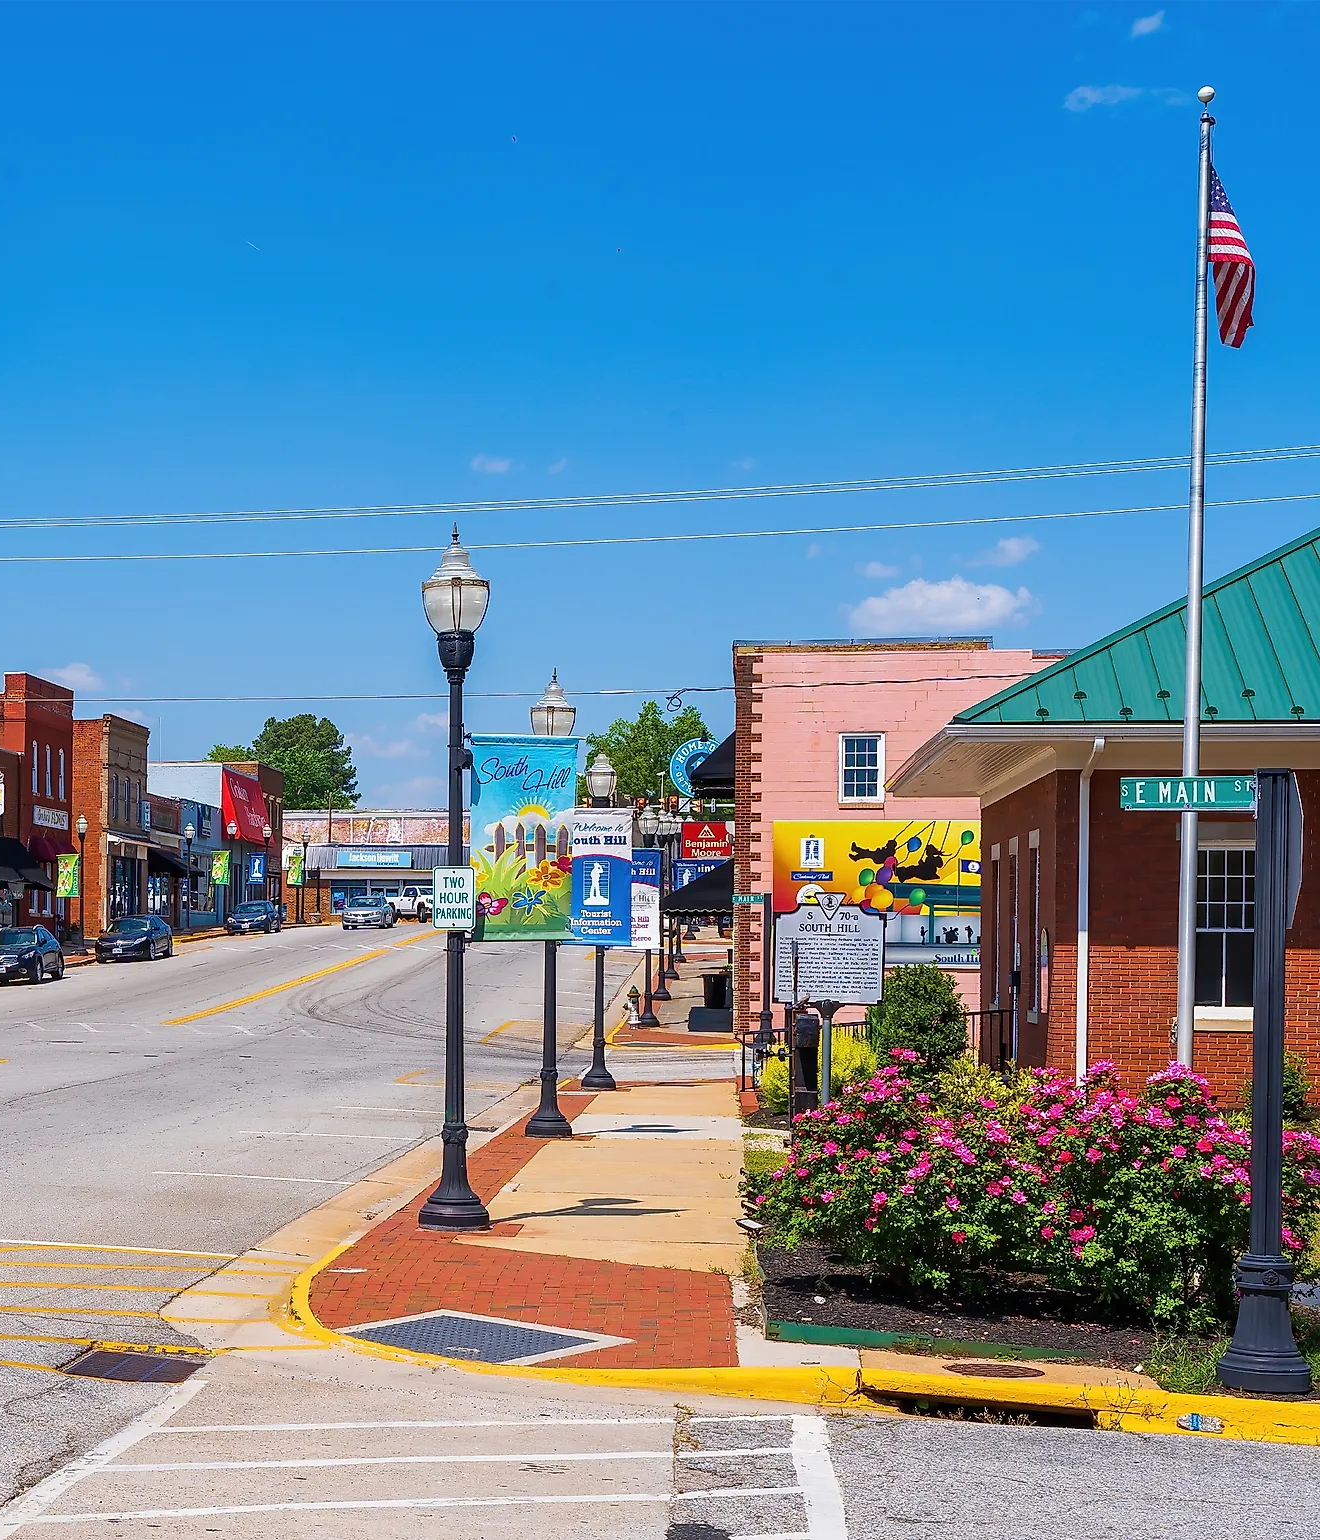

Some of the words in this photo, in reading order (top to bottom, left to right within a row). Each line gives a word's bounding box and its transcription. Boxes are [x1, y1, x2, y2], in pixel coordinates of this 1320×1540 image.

[479, 754, 529, 785] South
[522, 765, 570, 793] Hill
[1136, 781, 1145, 803] E
[1159, 781, 1216, 803] MAIN
[1235, 780, 1253, 792] ST
[573, 822, 613, 832] Welcome
[614, 823, 624, 832] to
[573, 835, 601, 845] outh
[603, 835, 627, 845] Hill
[685, 839, 728, 849] Benjamin
[348, 853, 376, 862] Jackson
[376, 853, 399, 862] Hewitt
[691, 849, 721, 857] Moore
[639, 868, 656, 876] Hill
[443, 876, 465, 888] TWO
[440, 892, 468, 904] HOUR
[435, 907, 472, 920] PARKING
[580, 909, 612, 918] Tourist
[806, 911, 814, 919] S
[570, 918, 622, 927] Information
[580, 926, 612, 935] Center
[799, 923, 832, 933] SOUTH
[837, 924, 861, 933] HILL
[935, 953, 964, 963] South
